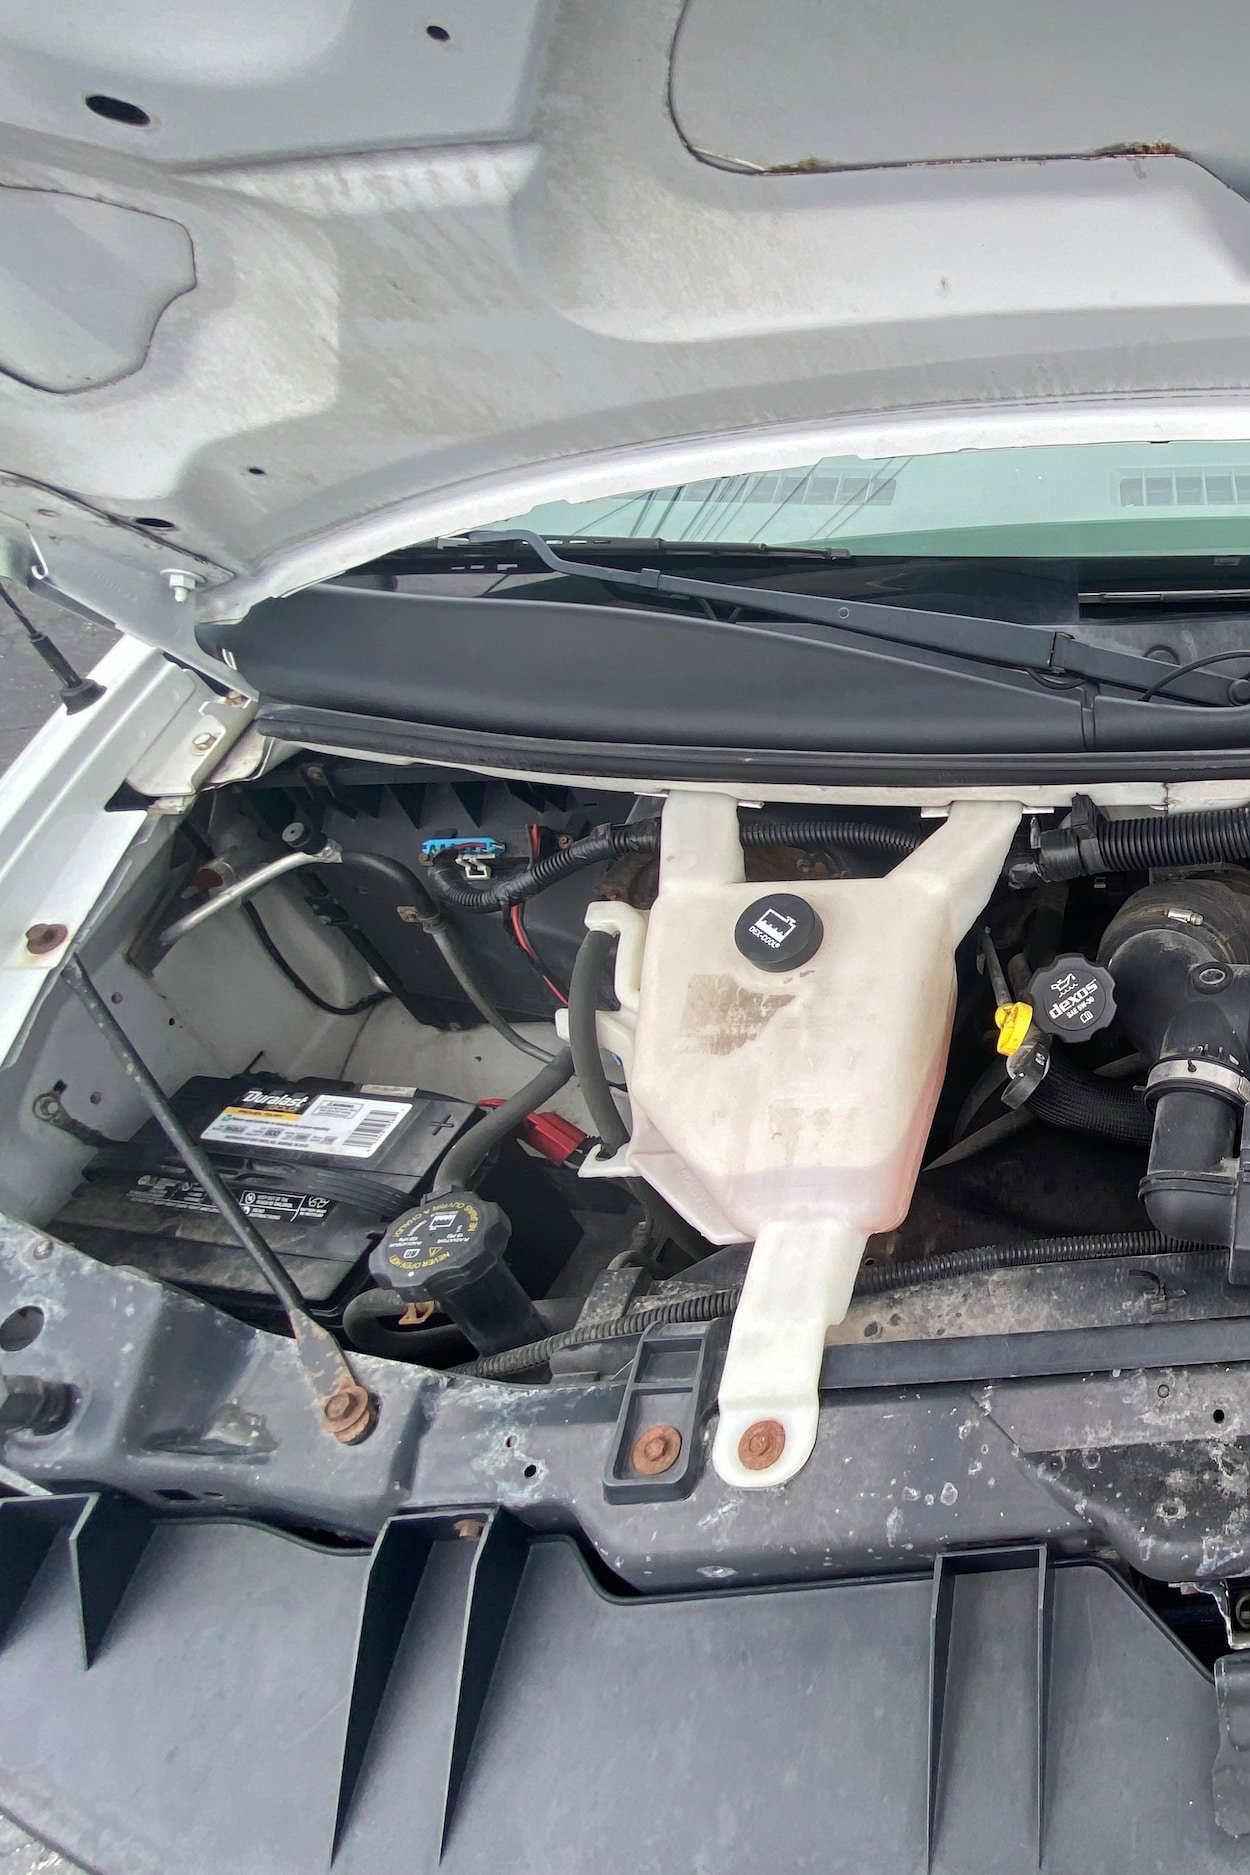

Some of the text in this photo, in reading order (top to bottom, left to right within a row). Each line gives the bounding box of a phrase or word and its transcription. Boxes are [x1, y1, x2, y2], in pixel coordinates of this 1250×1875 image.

[1048, 983, 1098, 1019] dexos
[1066, 1007, 1079, 1019] SAE
[242, 1090, 310, 1107] Duralast
[422, 1252, 450, 1267] NEVER
